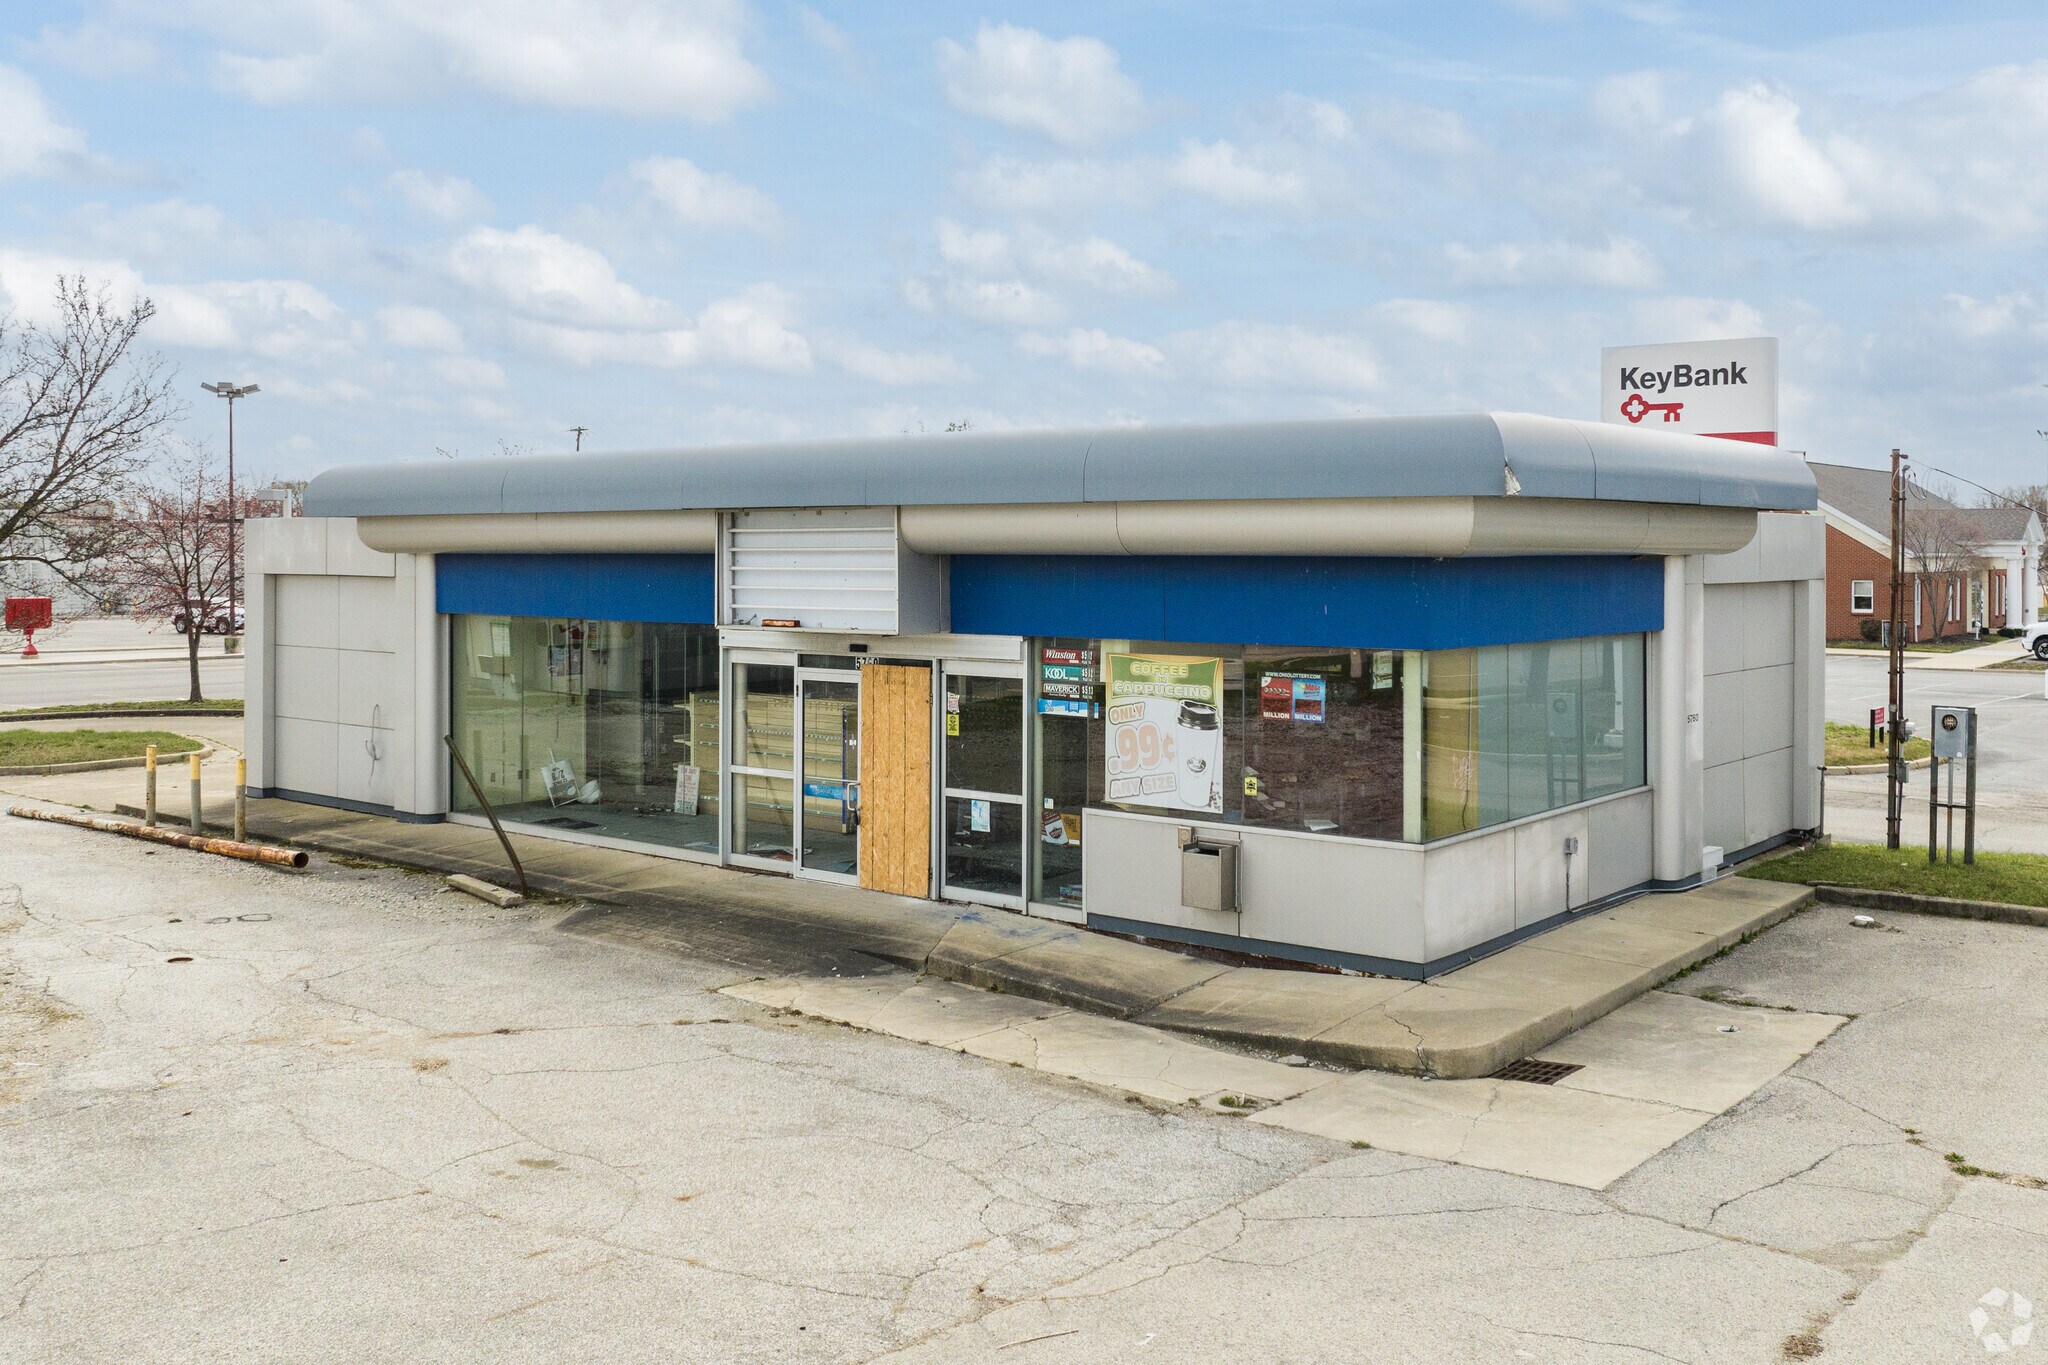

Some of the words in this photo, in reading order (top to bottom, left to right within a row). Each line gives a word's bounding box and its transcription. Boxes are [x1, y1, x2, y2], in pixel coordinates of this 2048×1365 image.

[1620, 361, 1747, 393] KeyBank
[1045, 649, 1076, 660] Winston
[1045, 667, 1068, 680] KOOL
[1131, 662, 1188, 676] COFFEE
[1157, 676, 1168, 684] OR
[1045, 685, 1078, 694] MAVERICK
[1113, 681, 1212, 699] CAPPUCCINO
[1111, 704, 1144, 722] ONLY
[1263, 711, 1290, 719] MILLION
[1294, 713, 1322, 721] MILLION
[1111, 779, 1139, 797] ANY
[1142, 775, 1175, 792] SIZE
